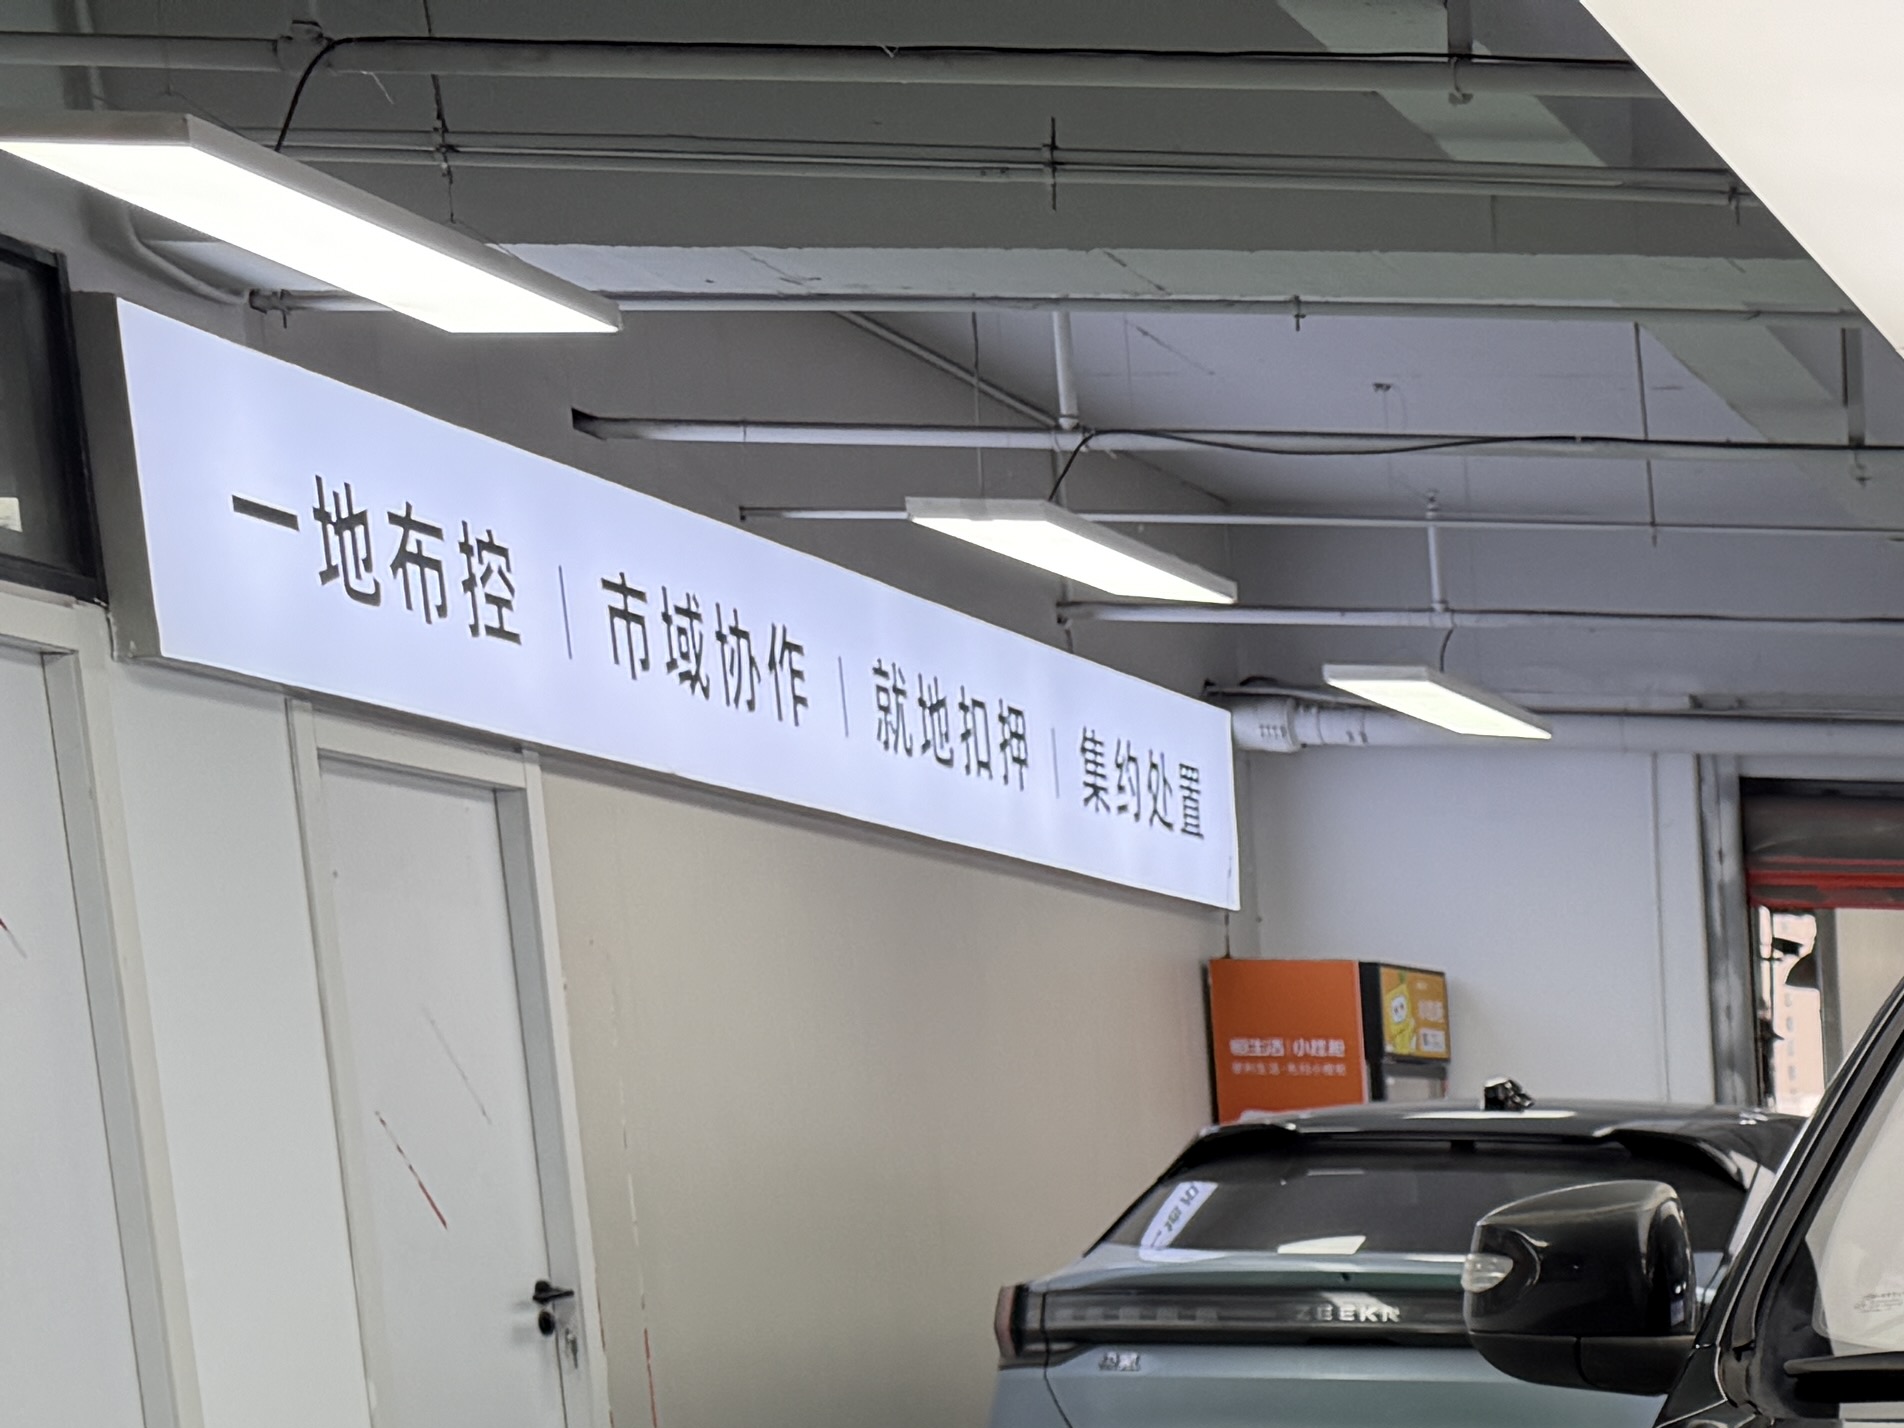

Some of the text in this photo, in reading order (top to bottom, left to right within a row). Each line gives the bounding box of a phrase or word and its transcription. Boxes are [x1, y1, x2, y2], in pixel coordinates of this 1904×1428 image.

[231, 474, 1204, 839] 一地布控 市域协作 就地扣押 集约处置
[1295, 1303, 1401, 1323] ZEEKR
